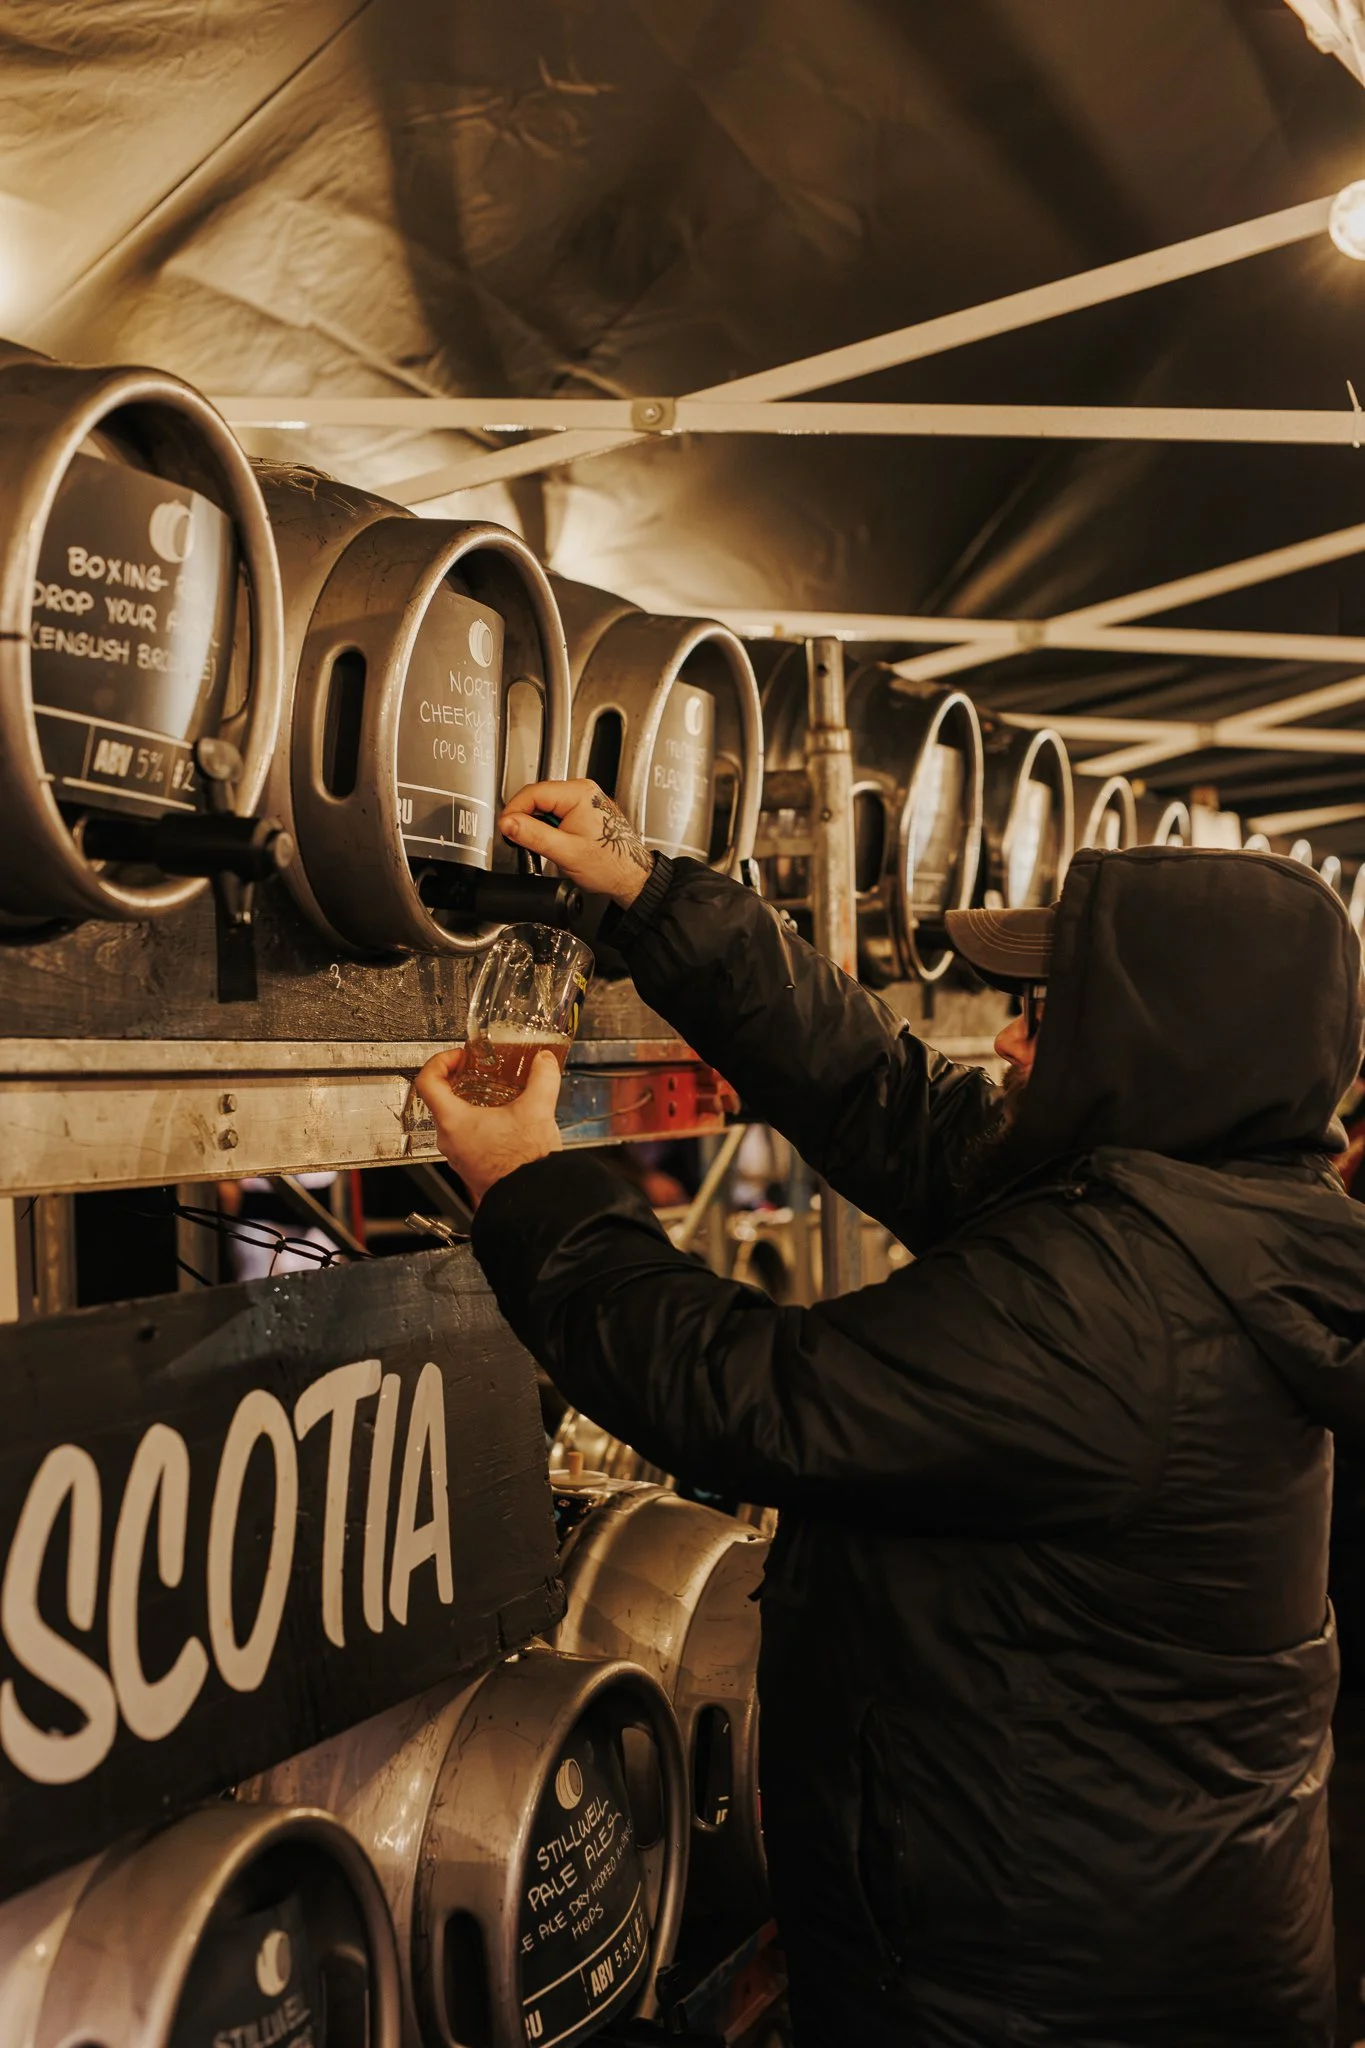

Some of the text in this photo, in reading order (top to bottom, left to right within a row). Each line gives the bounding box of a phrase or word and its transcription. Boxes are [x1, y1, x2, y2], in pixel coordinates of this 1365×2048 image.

[67, 546, 169, 593] BOXING
[104, 596, 157, 632] YOUR
[449, 670, 498, 707] NORTH
[93, 739, 133, 777] ABV
[458, 809, 478, 837] ABV
[0, 1359, 453, 1785] SCOTIA
[527, 1863, 578, 1912] PALE
[538, 1911, 568, 1941] ALE
[569, 1889, 590, 1917] DRY
[571, 1902, 604, 1940] HOPS
[590, 1954, 614, 1998] ABV
